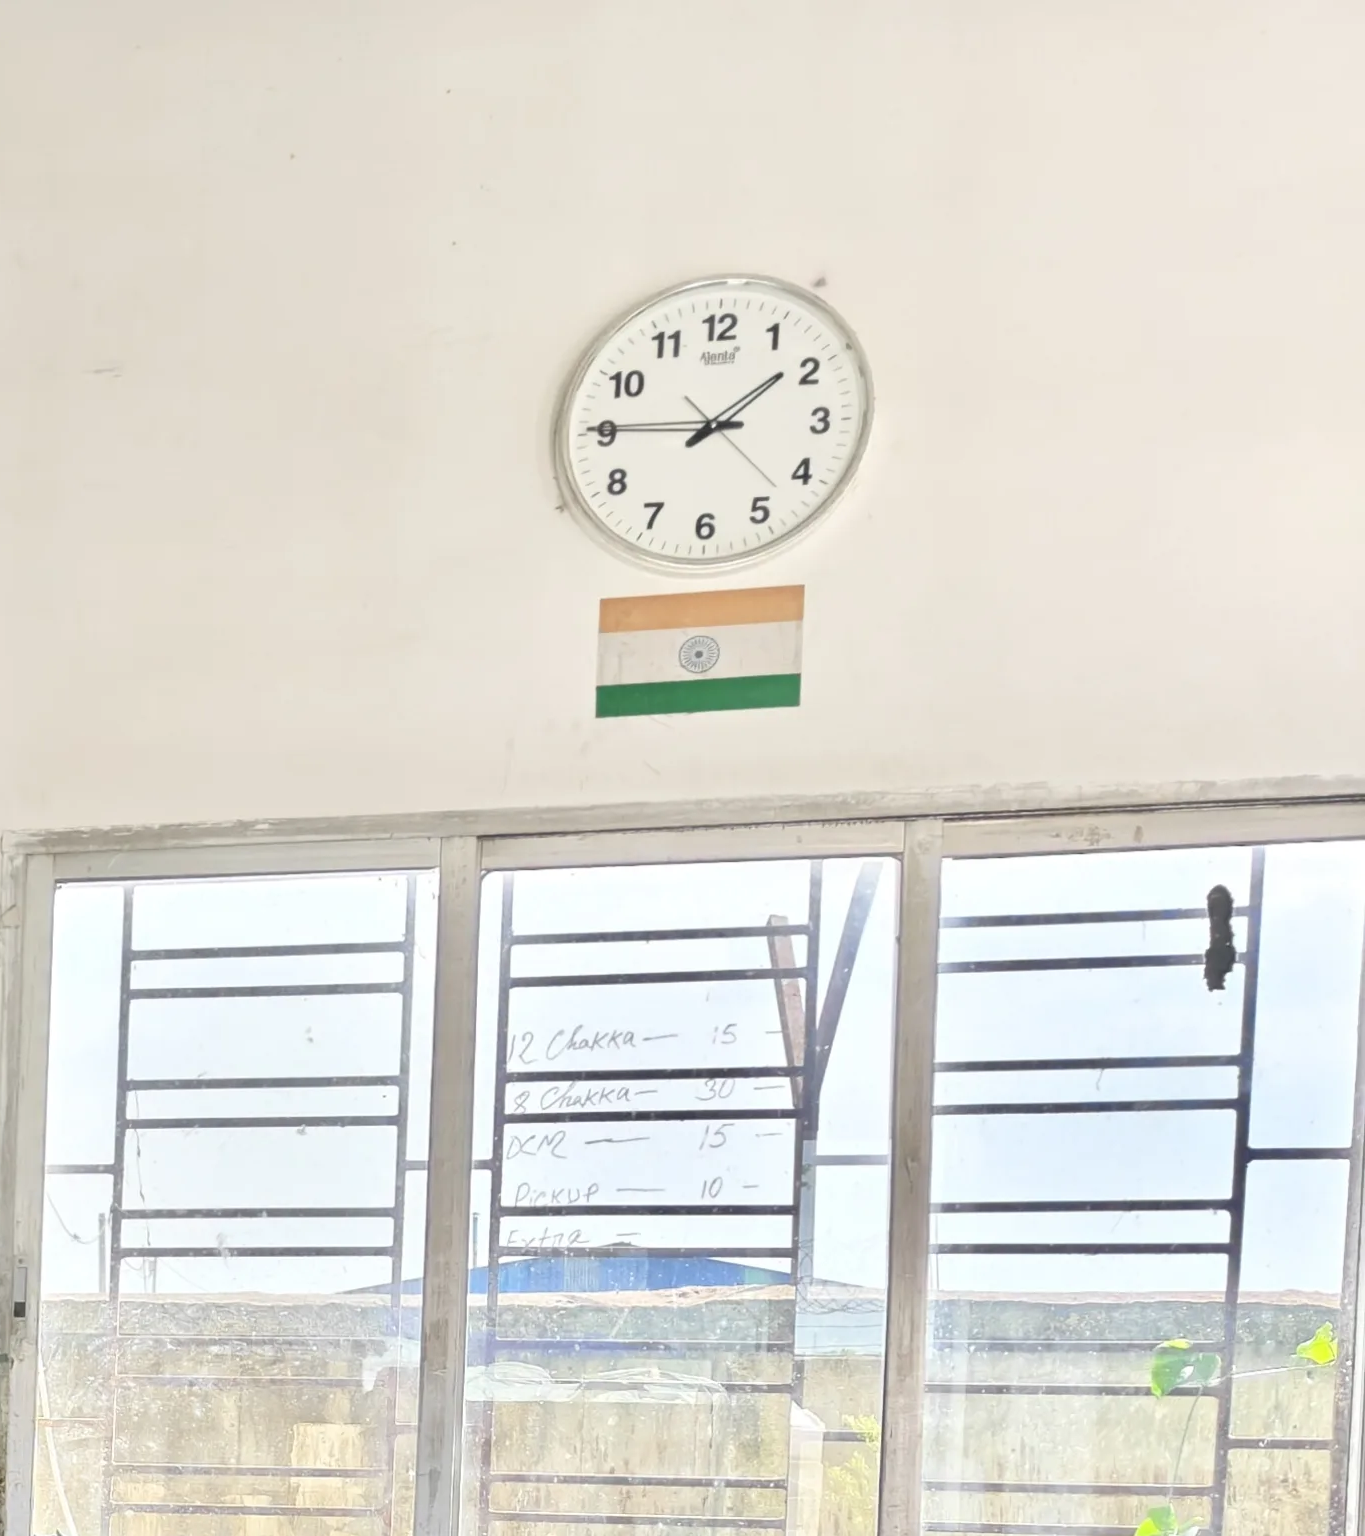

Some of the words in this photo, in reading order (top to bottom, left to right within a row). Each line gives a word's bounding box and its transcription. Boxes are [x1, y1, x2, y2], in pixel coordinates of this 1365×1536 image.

[702, 313, 739, 342] 12
[765, 323, 781, 351] 1
[651, 330, 681, 359] 11
[609, 370, 645, 399] 10
[798, 357, 820, 385] 2
[596, 420, 618, 447] 9
[810, 407, 831, 434] 3
[607, 468, 628, 496] 8
[791, 457, 813, 485] 4
[643, 502, 665, 530] 7
[749, 496, 770, 524] 5
[695, 513, 716, 540] 6
[508, 1032, 538, 1064] 12
[695, 1078, 735, 1101] 30
[700, 1124, 735, 1150] 15
[701, 1177, 723, 1199] 10
